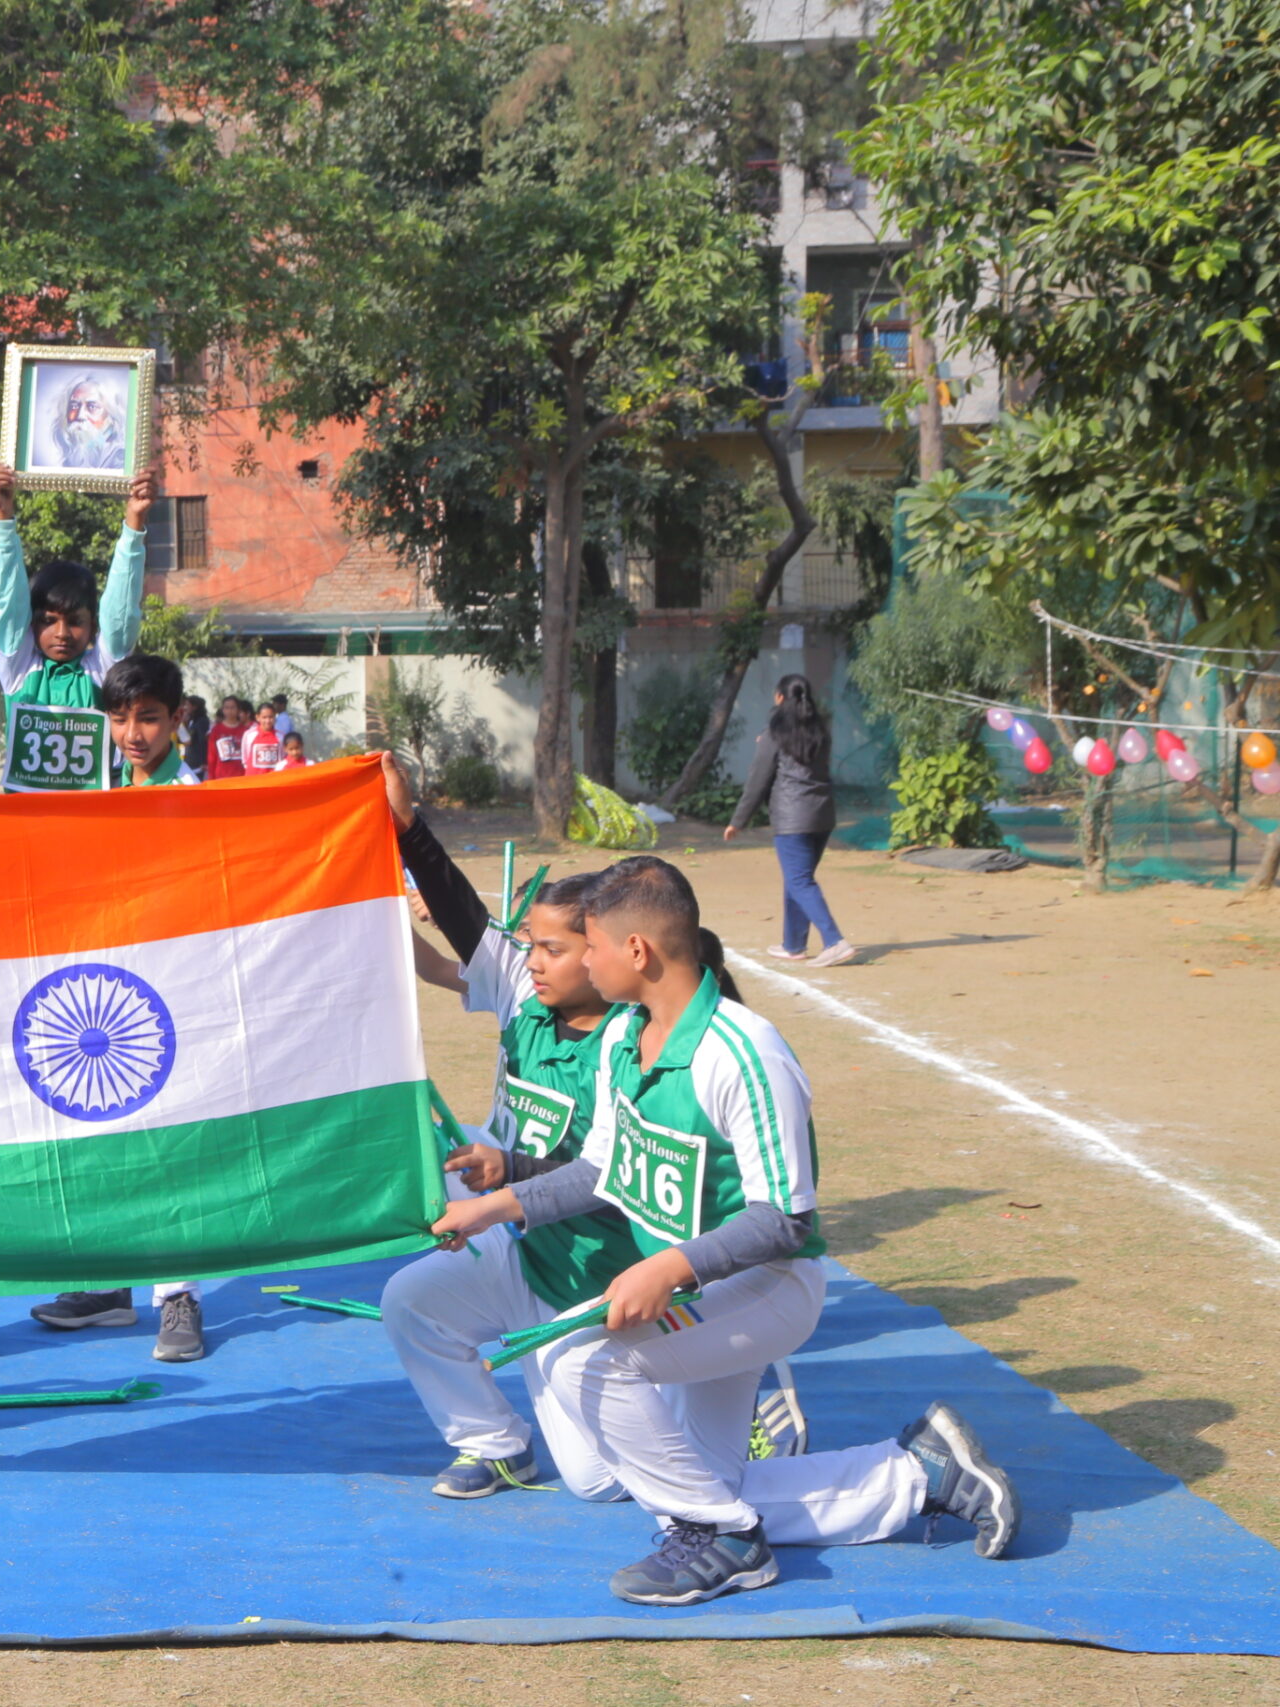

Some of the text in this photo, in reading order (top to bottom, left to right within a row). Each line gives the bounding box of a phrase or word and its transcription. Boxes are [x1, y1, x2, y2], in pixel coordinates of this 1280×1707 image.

[65, 719, 98, 732] House
[21, 732, 93, 775] 335
[517, 1095, 560, 1124] House
[646, 1138, 689, 1165] House
[618, 1133, 683, 1217] 316
